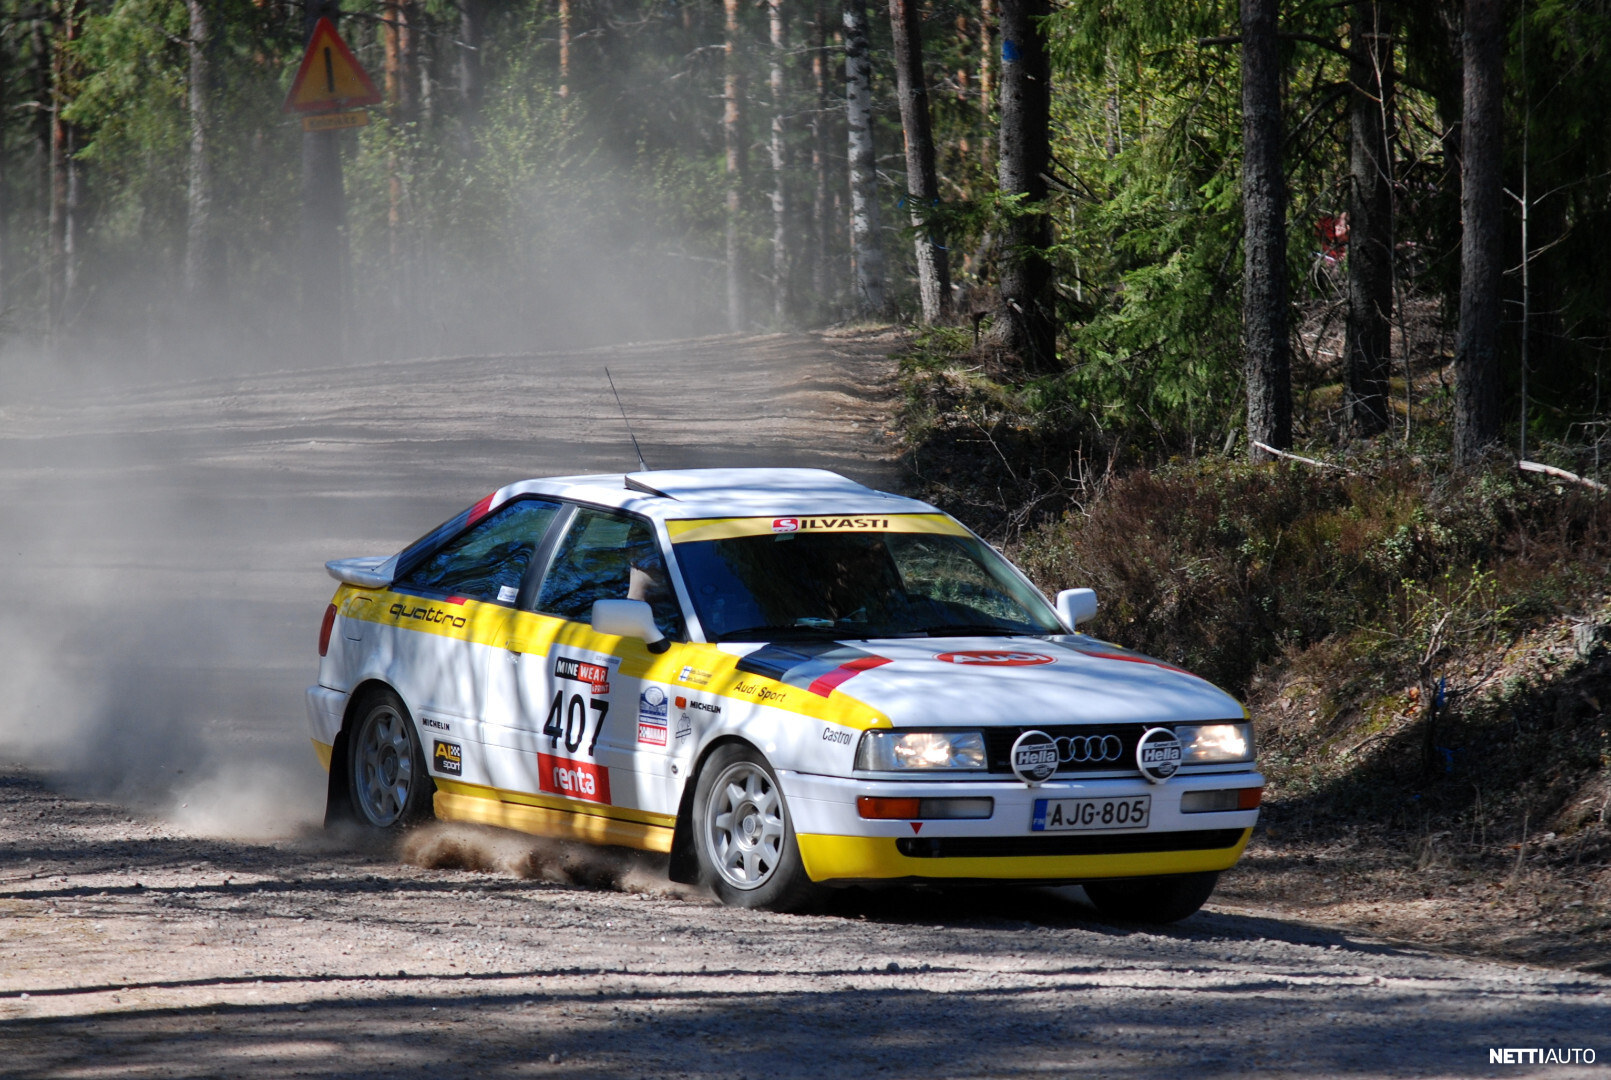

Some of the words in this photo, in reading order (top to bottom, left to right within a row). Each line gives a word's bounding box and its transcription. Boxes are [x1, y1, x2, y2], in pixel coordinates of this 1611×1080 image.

[771, 518, 889, 532] SILVASTI
[389, 603, 467, 628] quattro
[733, 681, 757, 695] Audi
[757, 687, 786, 703] Sport
[690, 700, 722, 714] MICHELIN
[422, 718, 451, 731] MICHELIN
[543, 690, 609, 756] 407
[822, 727, 854, 746] Castrol
[1018, 750, 1056, 765] Hella
[1143, 747, 1180, 762] Hella
[443, 760, 461, 771] sport
[553, 767, 596, 795] renta
[1050, 801, 1145, 826] AJG-805
